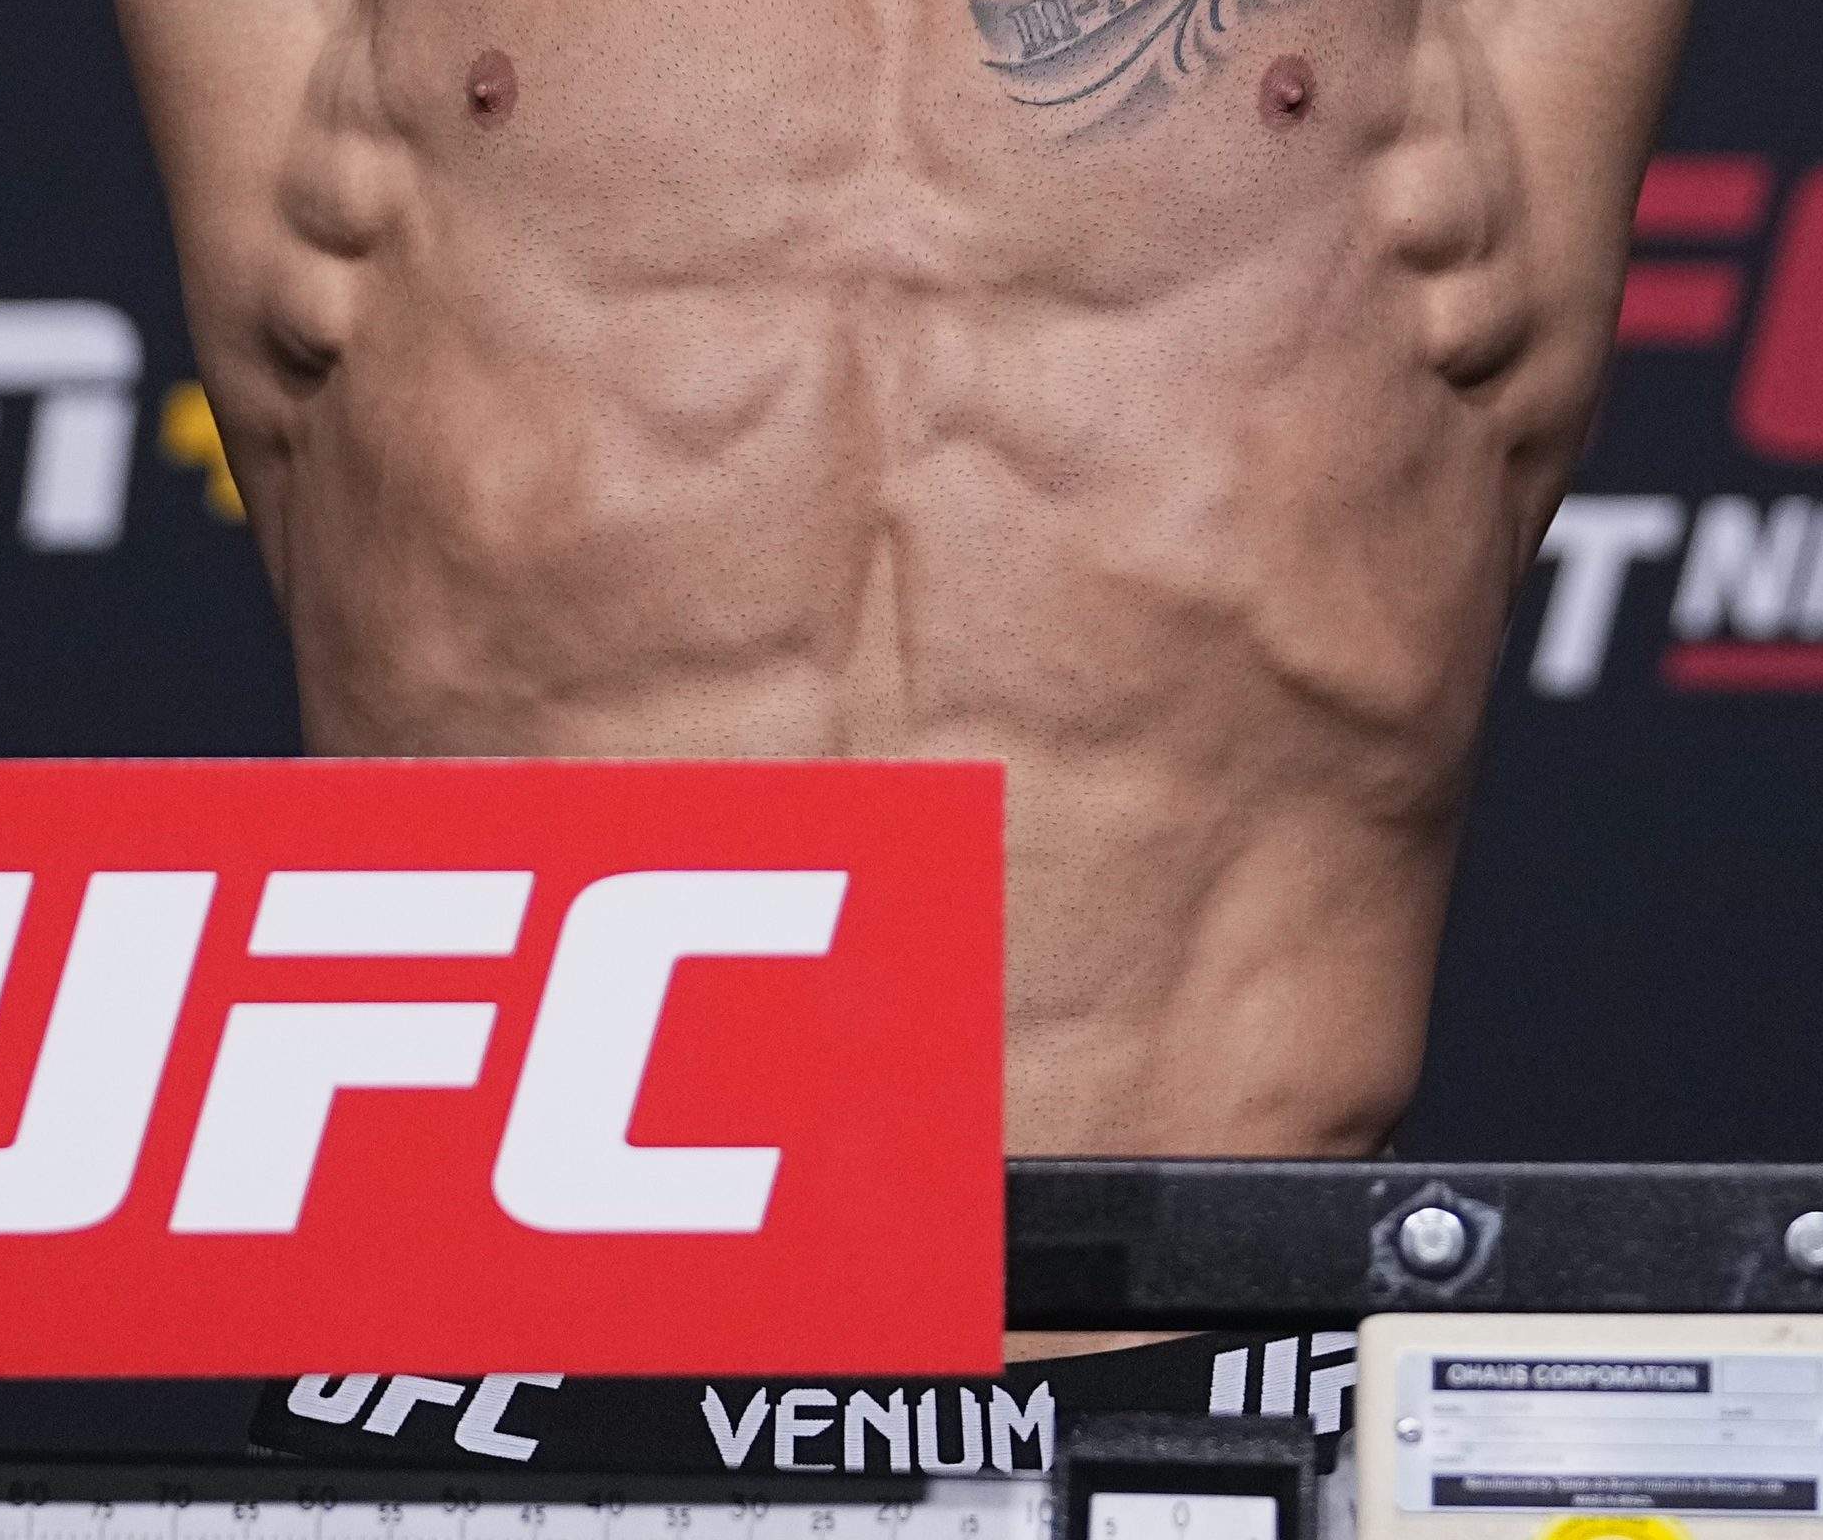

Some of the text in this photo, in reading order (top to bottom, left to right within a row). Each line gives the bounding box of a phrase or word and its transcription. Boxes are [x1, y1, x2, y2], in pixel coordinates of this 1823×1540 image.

[1445, 1363, 1698, 1390] OHAUS CORPORATION
[700, 1380, 1056, 1475] VENUM
